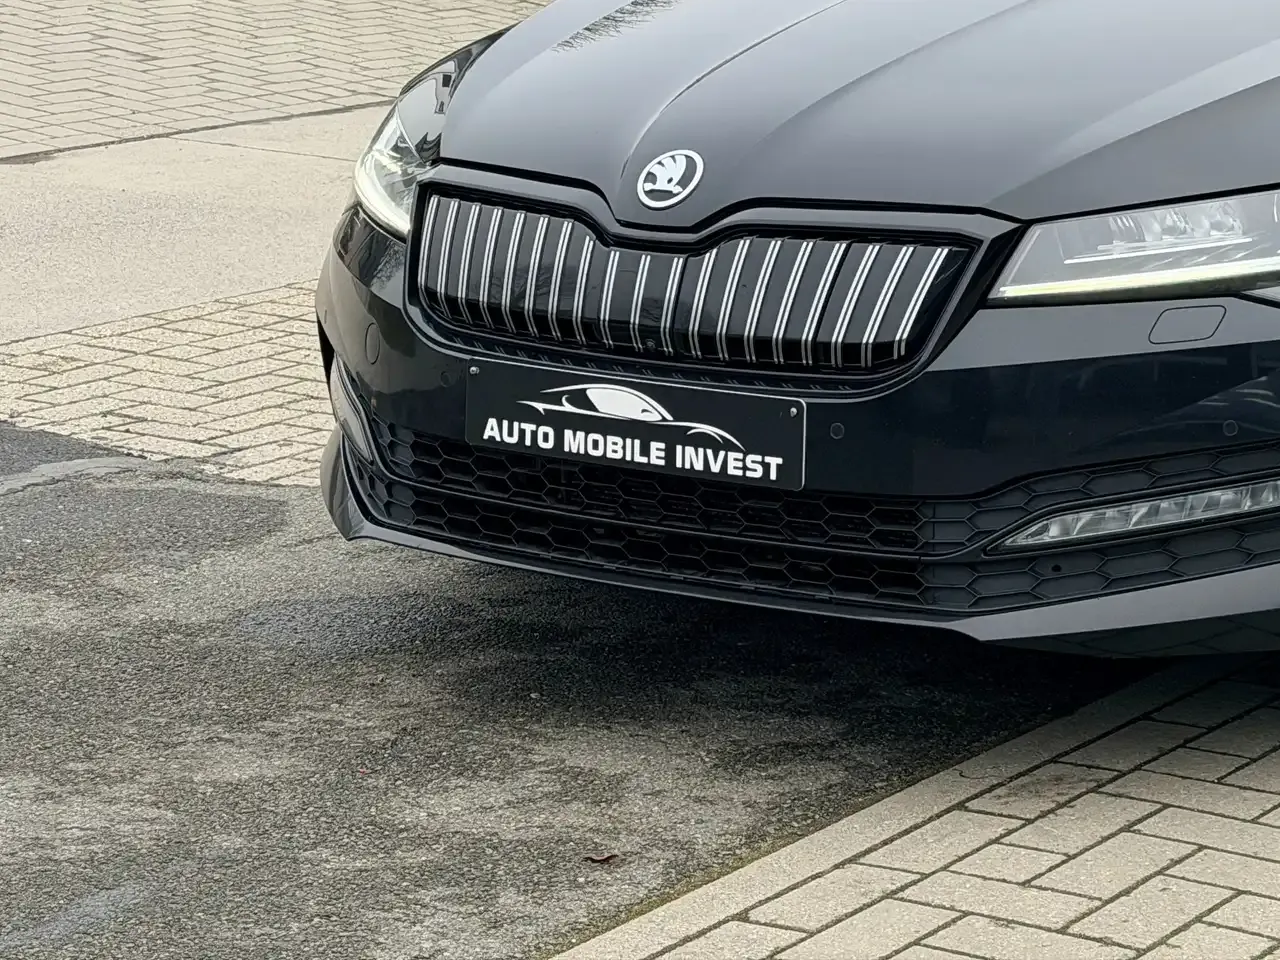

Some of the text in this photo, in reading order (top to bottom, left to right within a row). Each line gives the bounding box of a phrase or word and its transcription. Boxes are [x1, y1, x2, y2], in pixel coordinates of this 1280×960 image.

[482, 417, 784, 481] AUTO MOBILE INVEST
